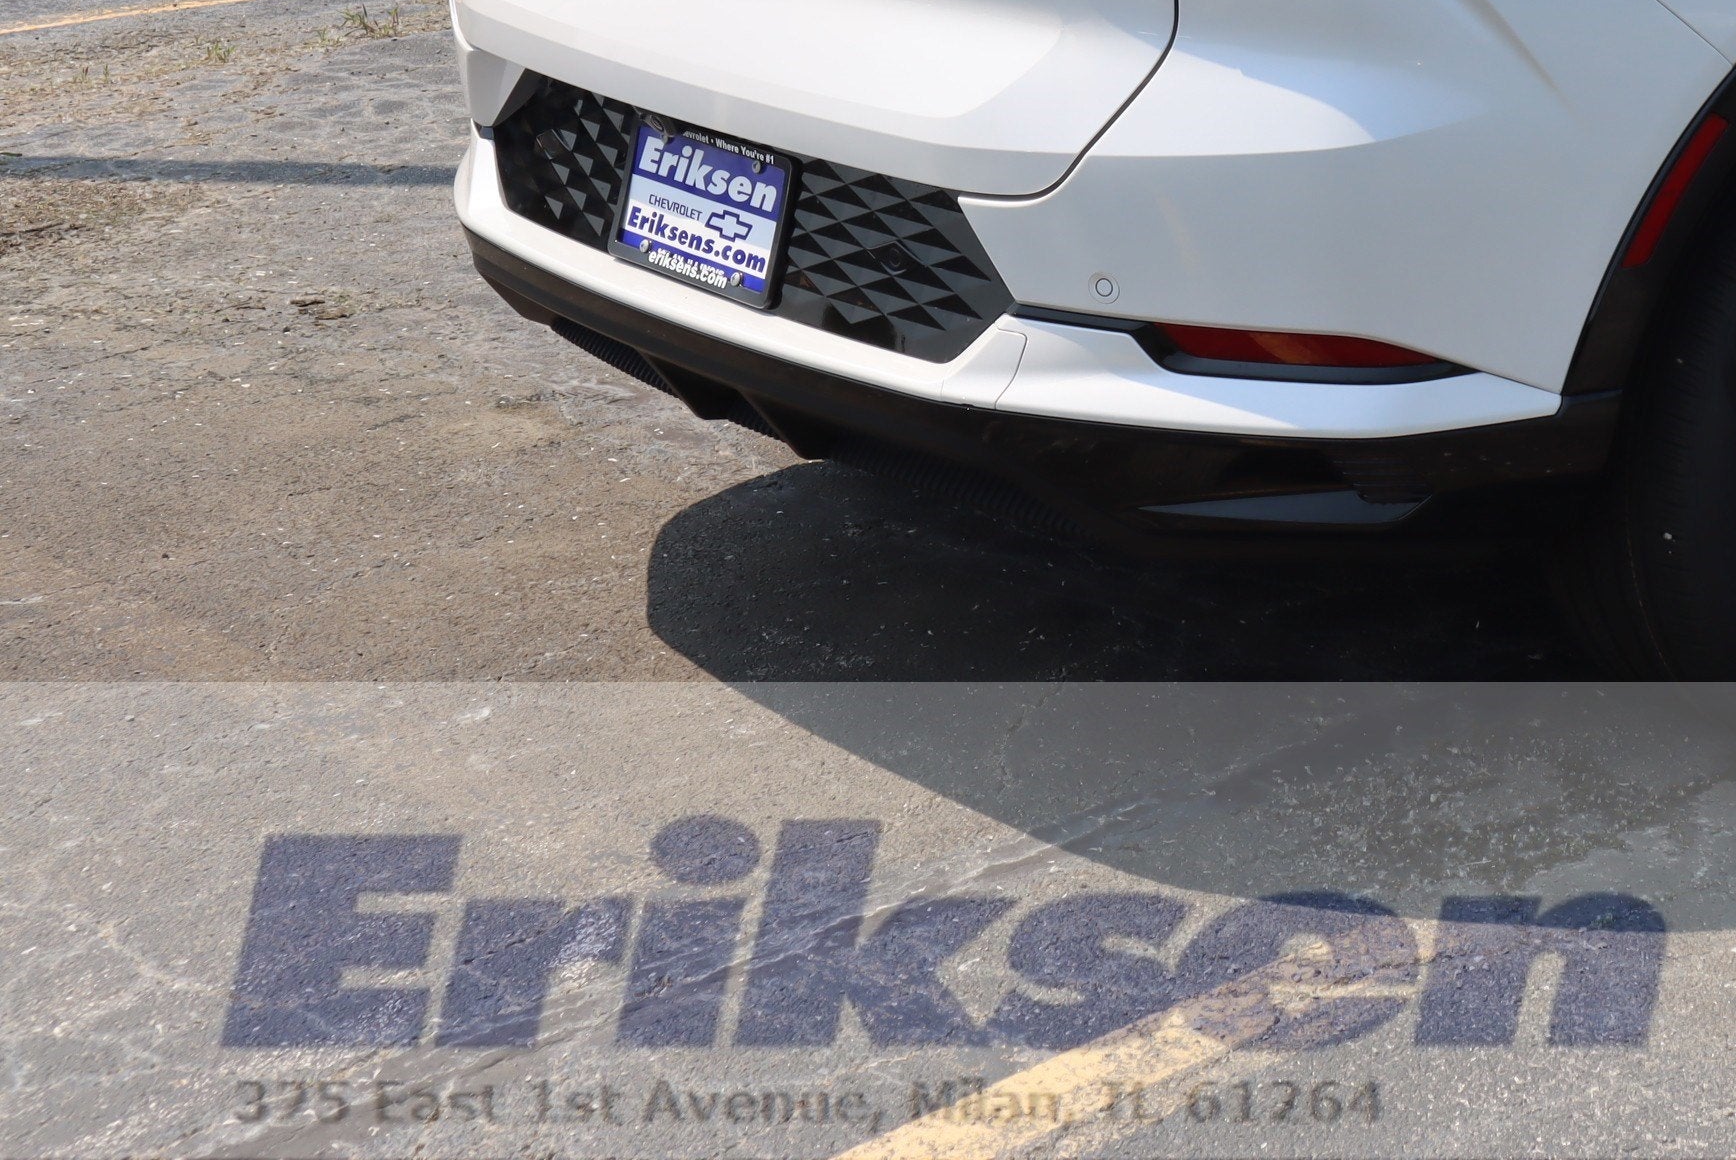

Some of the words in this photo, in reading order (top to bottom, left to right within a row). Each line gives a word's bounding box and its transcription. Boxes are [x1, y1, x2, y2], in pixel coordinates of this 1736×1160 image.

[683, 130, 709, 144] evrolet
[715, 138, 739, 153] Where
[741, 145, 765, 161] You're
[765, 154, 775, 165] #1
[638, 135, 777, 213] Eriksen
[648, 194, 703, 222] CHEVROLET
[626, 205, 767, 274] Eriksens.com
[648, 250, 728, 289] eriksens.com
